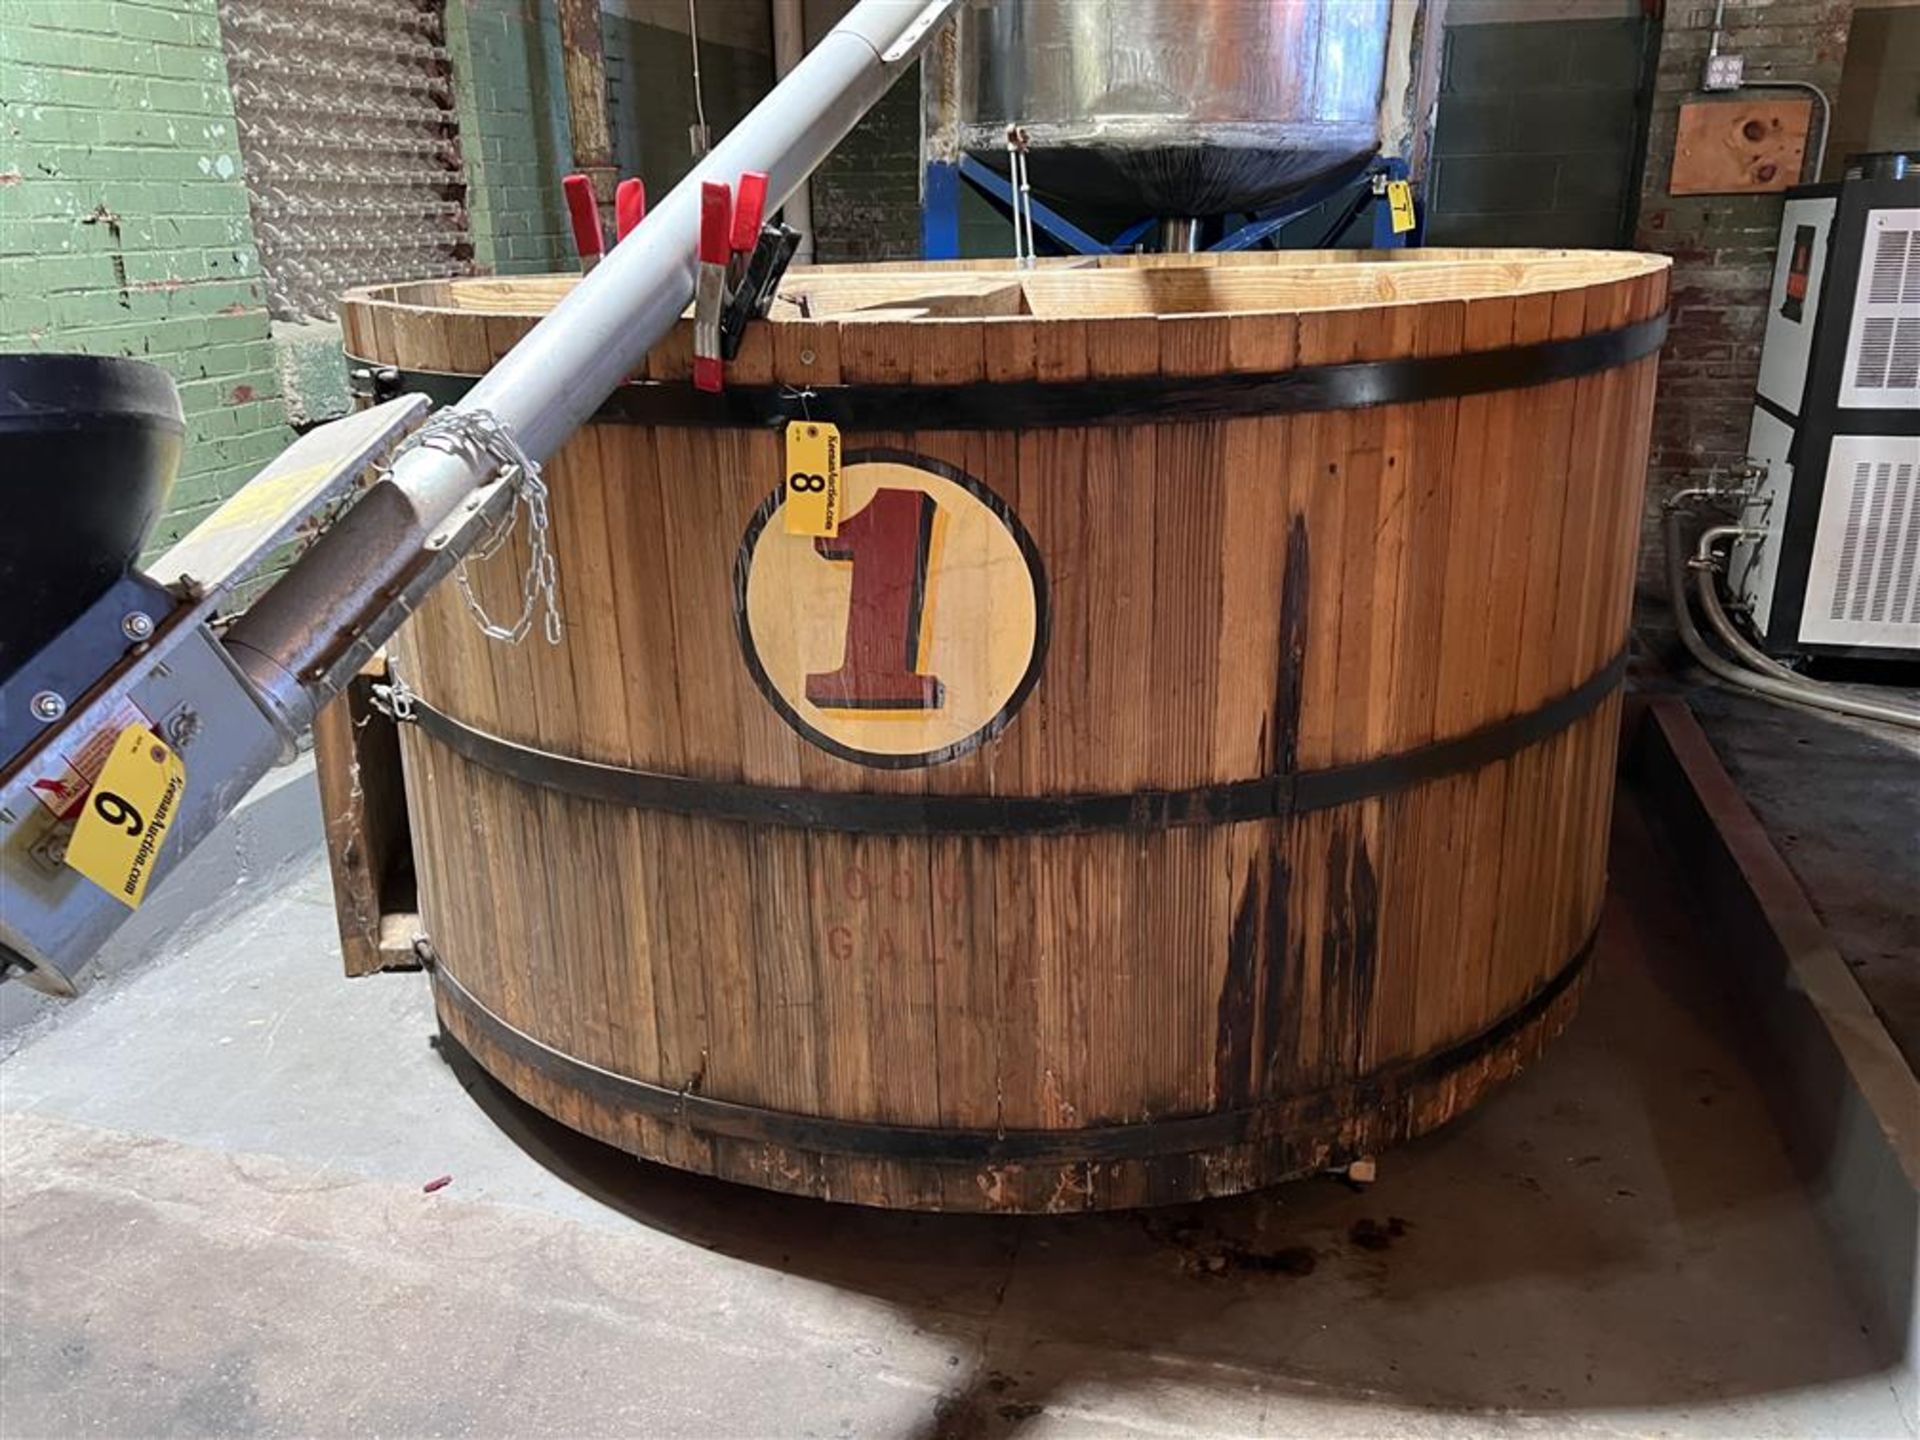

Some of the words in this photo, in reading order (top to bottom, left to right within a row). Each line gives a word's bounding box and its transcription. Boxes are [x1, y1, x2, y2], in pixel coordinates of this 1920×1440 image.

[1393, 202, 1407, 212] 7
[790, 472, 825, 493] 8
[805, 487, 945, 713] 1
